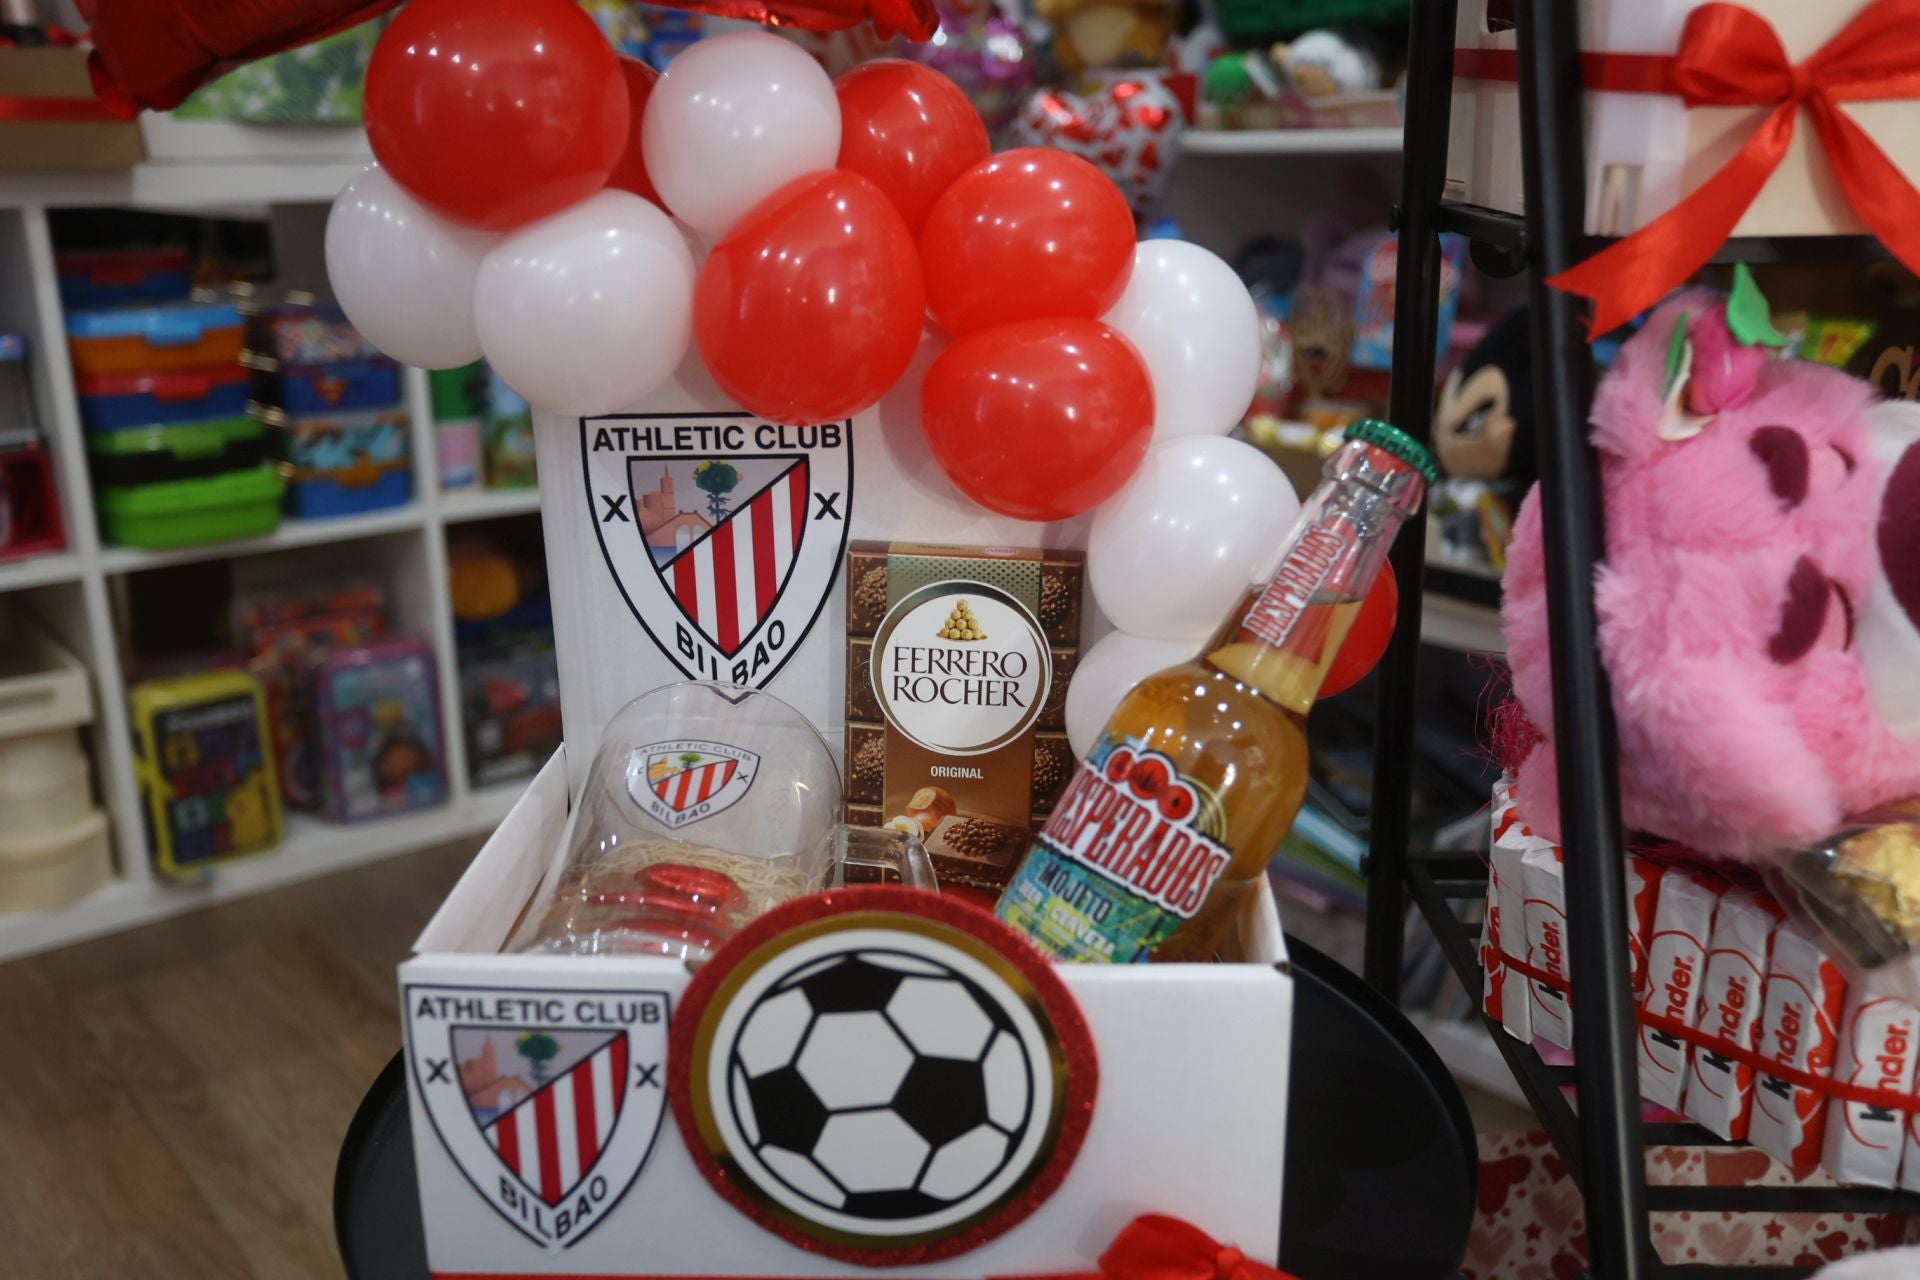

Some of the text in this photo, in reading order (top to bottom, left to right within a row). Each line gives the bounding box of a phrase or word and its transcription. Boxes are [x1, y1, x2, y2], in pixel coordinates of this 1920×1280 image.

[593, 424, 842, 451] ATHLETIC CLUB
[1243, 523, 1344, 644] DESPERADOS
[893, 646, 1028, 679] FERRERO
[893, 675, 1027, 708] ROCHER
[640, 743, 751, 761] ATHLETIC CLUB
[930, 765, 984, 780] ORIGINAL
[650, 800, 711, 826] BILBAO
[1043, 767, 1227, 914] ESPERADOS
[1037, 861, 1113, 924] MOJITO
[1050, 906, 1116, 956] CERVEZA
[1538, 920, 1564, 1001] Knder
[416, 997, 661, 1025] ATHLETIC CLUB
[1651, 955, 1695, 1050] Knder
[1702, 975, 1748, 1074] Knder
[1762, 1001, 1803, 1101] Knder
[1859, 1023, 1911, 1122] Knder
[499, 1175, 608, 1240] BILBAO
